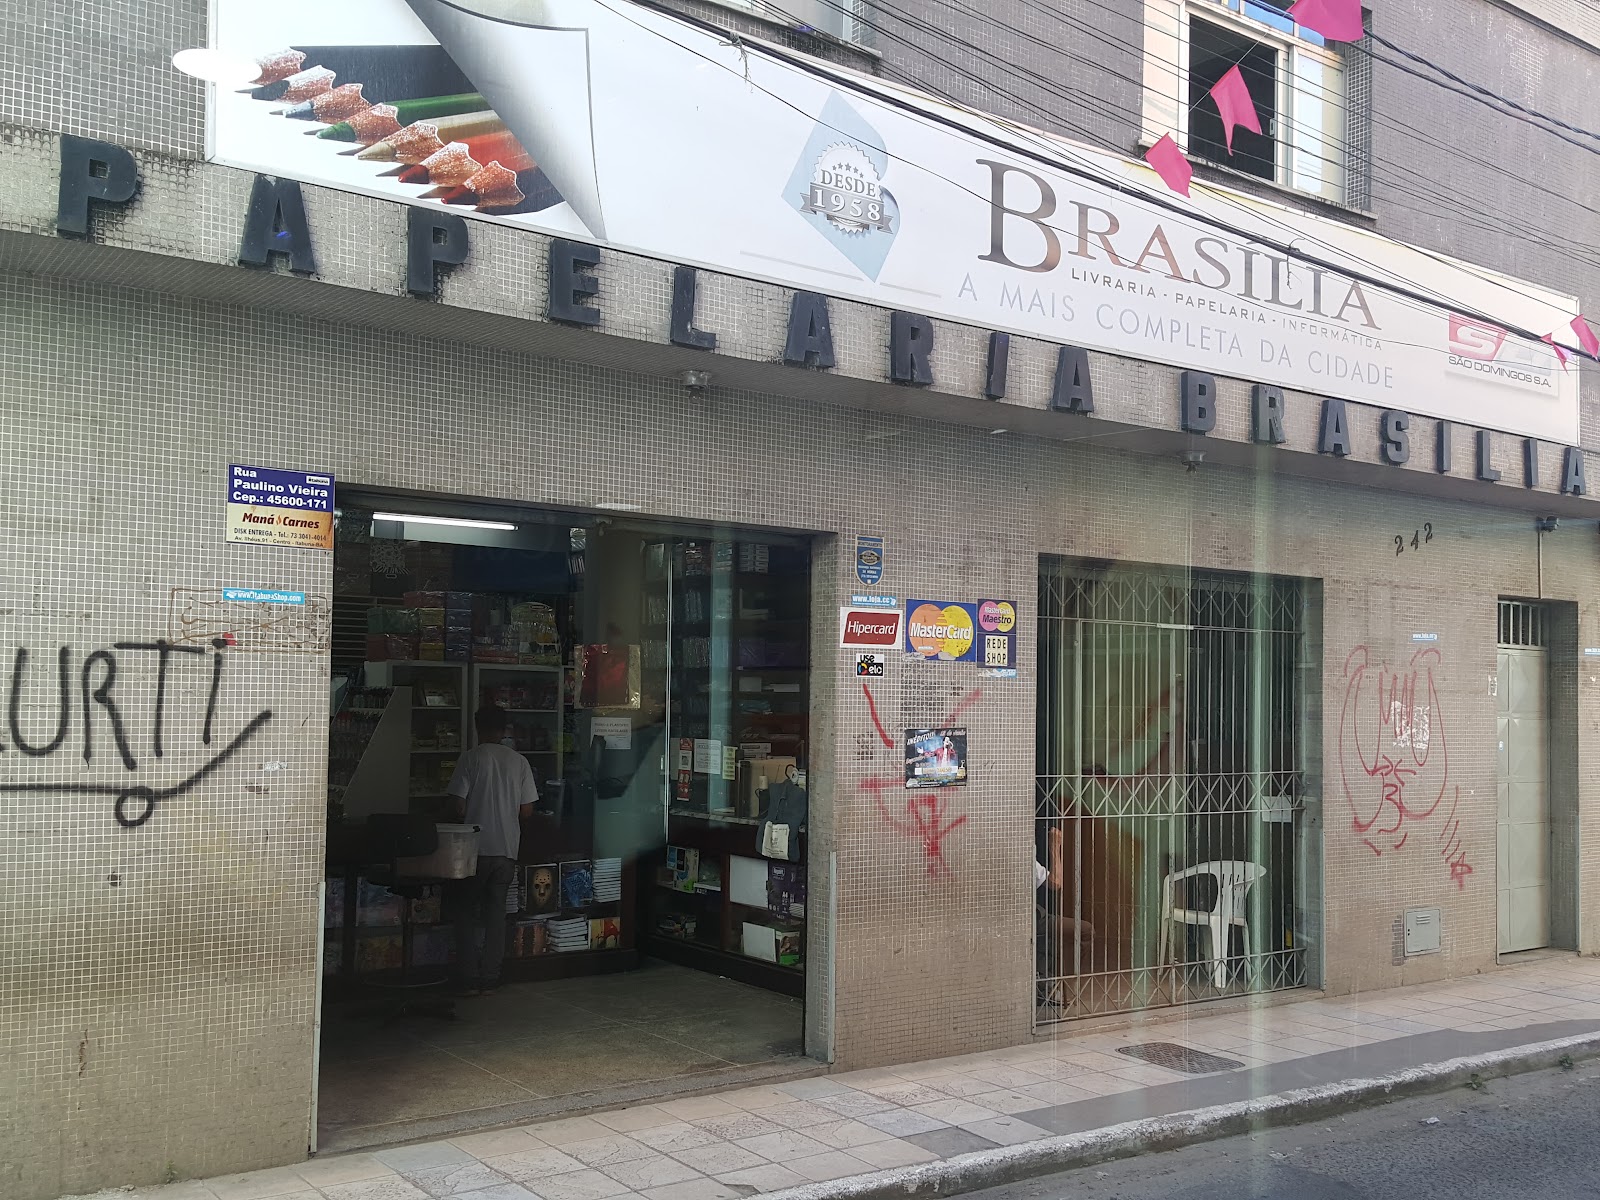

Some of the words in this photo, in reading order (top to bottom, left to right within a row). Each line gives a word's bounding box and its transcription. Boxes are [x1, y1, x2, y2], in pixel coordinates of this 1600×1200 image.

[820, 169, 876, 198] DESDE
[813, 189, 881, 221] 1958
[57, 133, 1095, 414] PAPELARIA
[1181, 371, 1586, 495] BRASILIA
[1071, 267, 1157, 299] LIVRARIA
[1175, 292, 1267, 324] PAPELARIA
[1282, 318, 1383, 351] INFORMÁTICA
[957, 272, 978, 302] A
[999, 281, 1076, 323] MAIS
[1095, 303, 1244, 359] COMPLETA
[1260, 338, 1293, 369] DA
[1307, 350, 1394, 389] CIDADE
[1473, 361, 1533, 383] DOMINGOS
[1532, 375, 1552, 388] S.A.
[233, 466, 257, 478] Rua
[233, 478, 285, 493] Paulino
[288, 484, 328, 498] Vieira
[232, 491, 264, 504] Cep.:
[266, 494, 327, 510] 45600-171
[242, 512, 275, 526] Maná
[282, 516, 320, 530] Carnes
[233, 527, 247, 535] DISK
[248, 528, 273, 537] ENTREGA
[1394, 522, 1433, 557] 242
[847, 620, 897, 637] Hipercard
[982, 613, 1012, 625] Maestro
[909, 622, 973, 641] MasterCard
[986, 637, 1007, 650] REDE
[859, 654, 875, 664] use
[986, 652, 1007, 664] SHOP
[868, 664, 883, 675] elo
